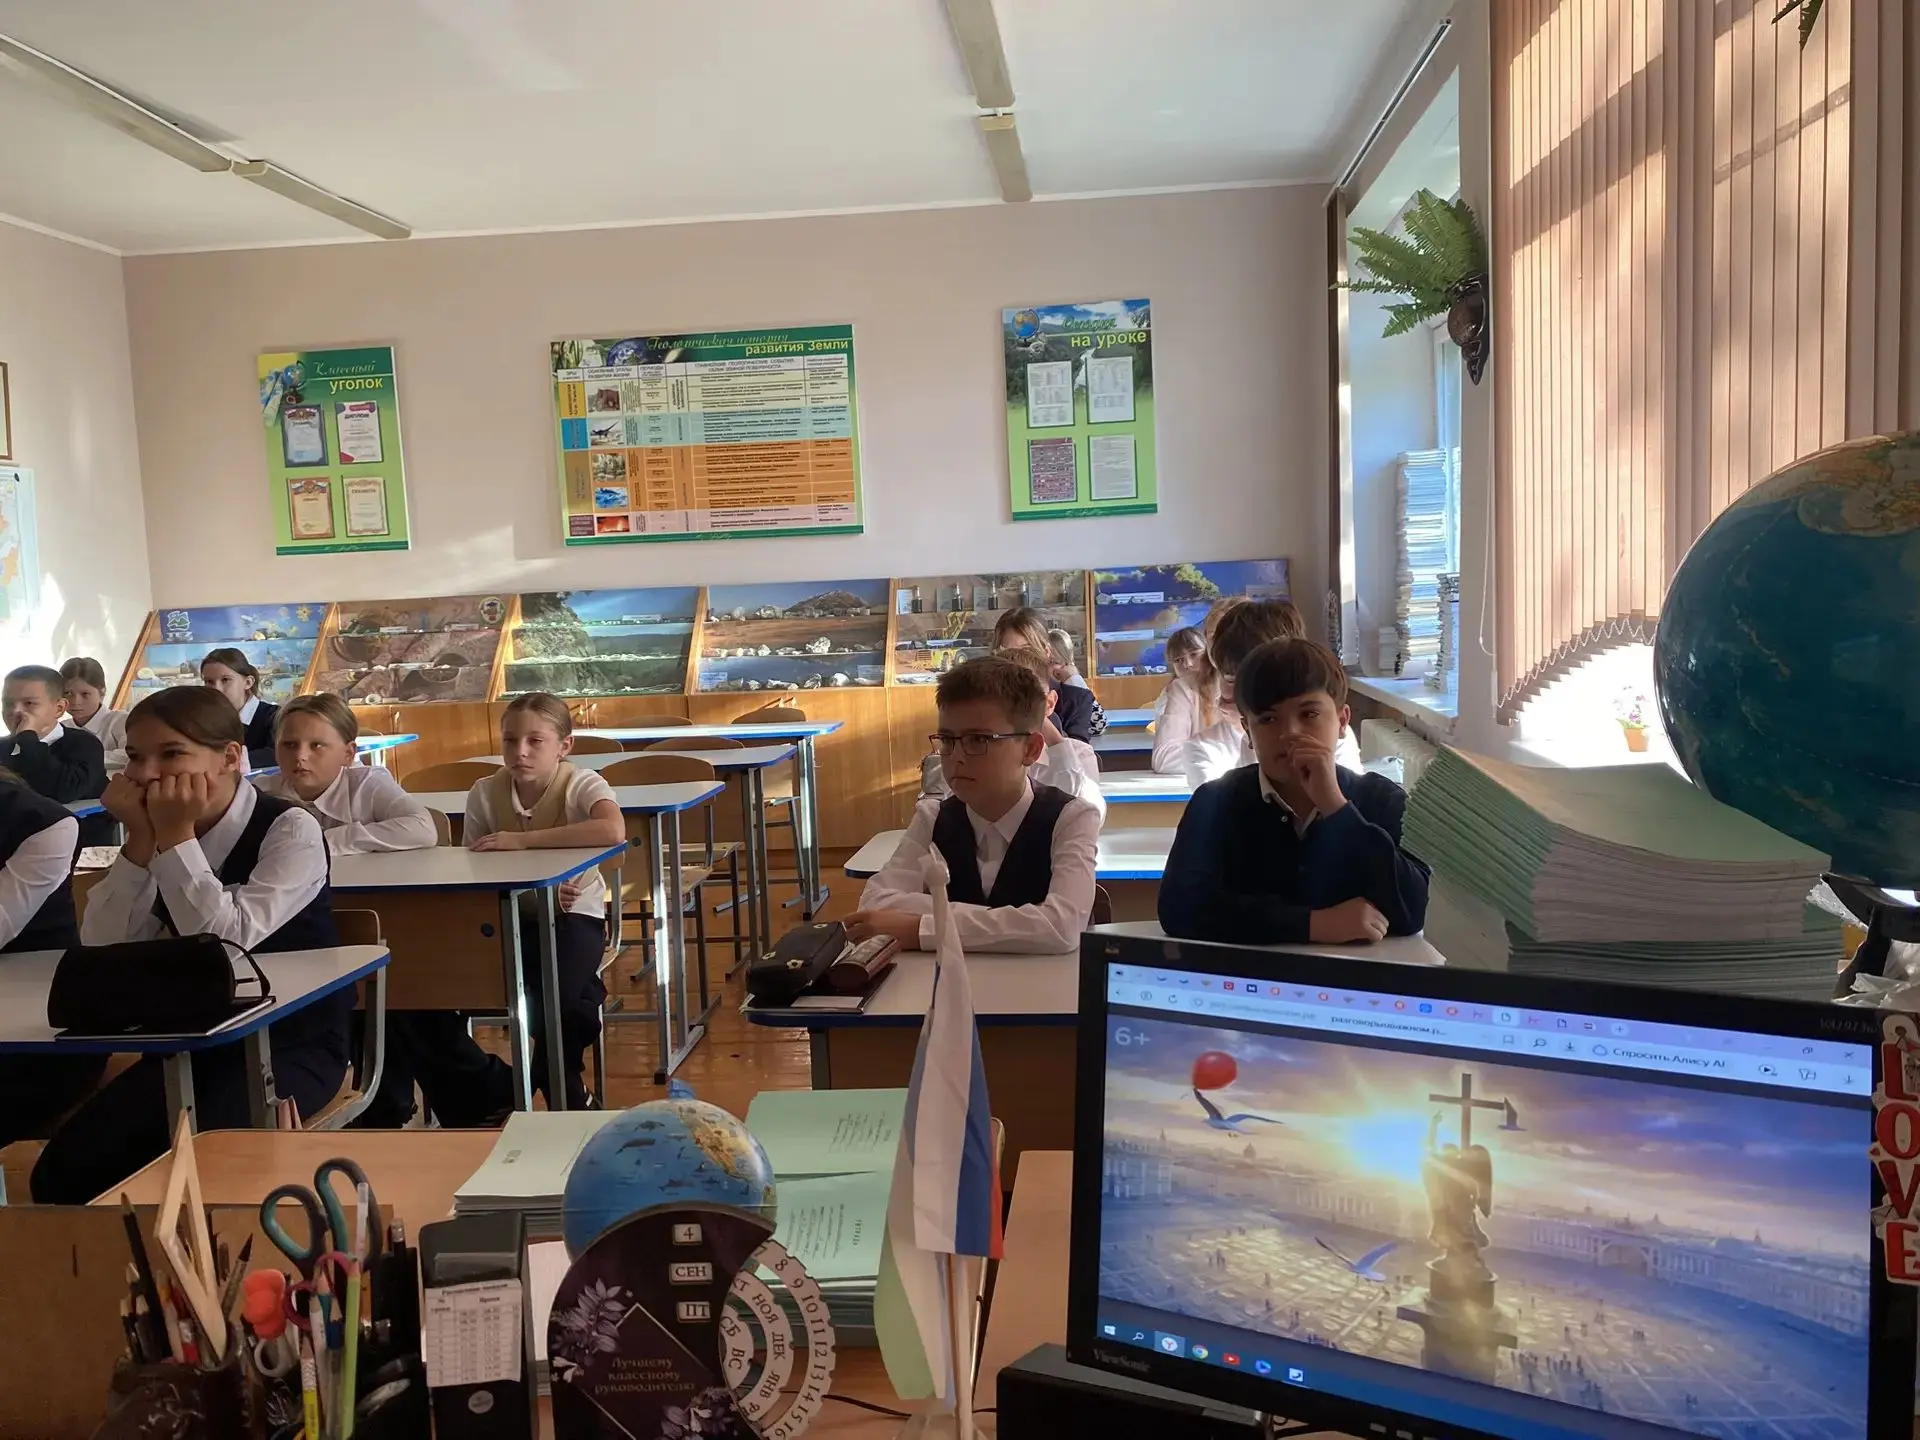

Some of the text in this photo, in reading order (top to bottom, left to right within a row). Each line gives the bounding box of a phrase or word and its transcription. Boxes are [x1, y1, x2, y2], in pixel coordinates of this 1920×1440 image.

[745, 340, 848, 356] развития Земли
[1071, 332, 1146, 349] на уроке
[329, 378, 383, 395] уголок
[1115, 1027, 1151, 1045] 6+
[1613, 1048, 1670, 1061] Спросить
[1672, 1055, 1709, 1068] Алису
[1876, 1043, 1920, 1281] LOVE
[683, 1226, 694, 1240] 4
[675, 1265, 707, 1278] СЕН
[775, 1259, 788, 1271] 8
[791, 1278, 804, 1289] 9
[685, 1304, 709, 1317] ПТ
[751, 1293, 779, 1325] НОЯ
[802, 1294, 818, 1314] 10
[810, 1318, 825, 1335] 11
[721, 1316, 745, 1371] СБ ВС
[772, 1332, 786, 1360] ДЕК
[814, 1340, 829, 1359] 12
[612, 1358, 673, 1369] Лучшему
[608, 1371, 680, 1381] классному
[809, 1365, 826, 1382] 13
[595, 1382, 695, 1395] руководителю
[759, 1370, 781, 1399] ЯНВ
[801, 1384, 820, 1402] 14
[791, 1405, 809, 1423] 15
